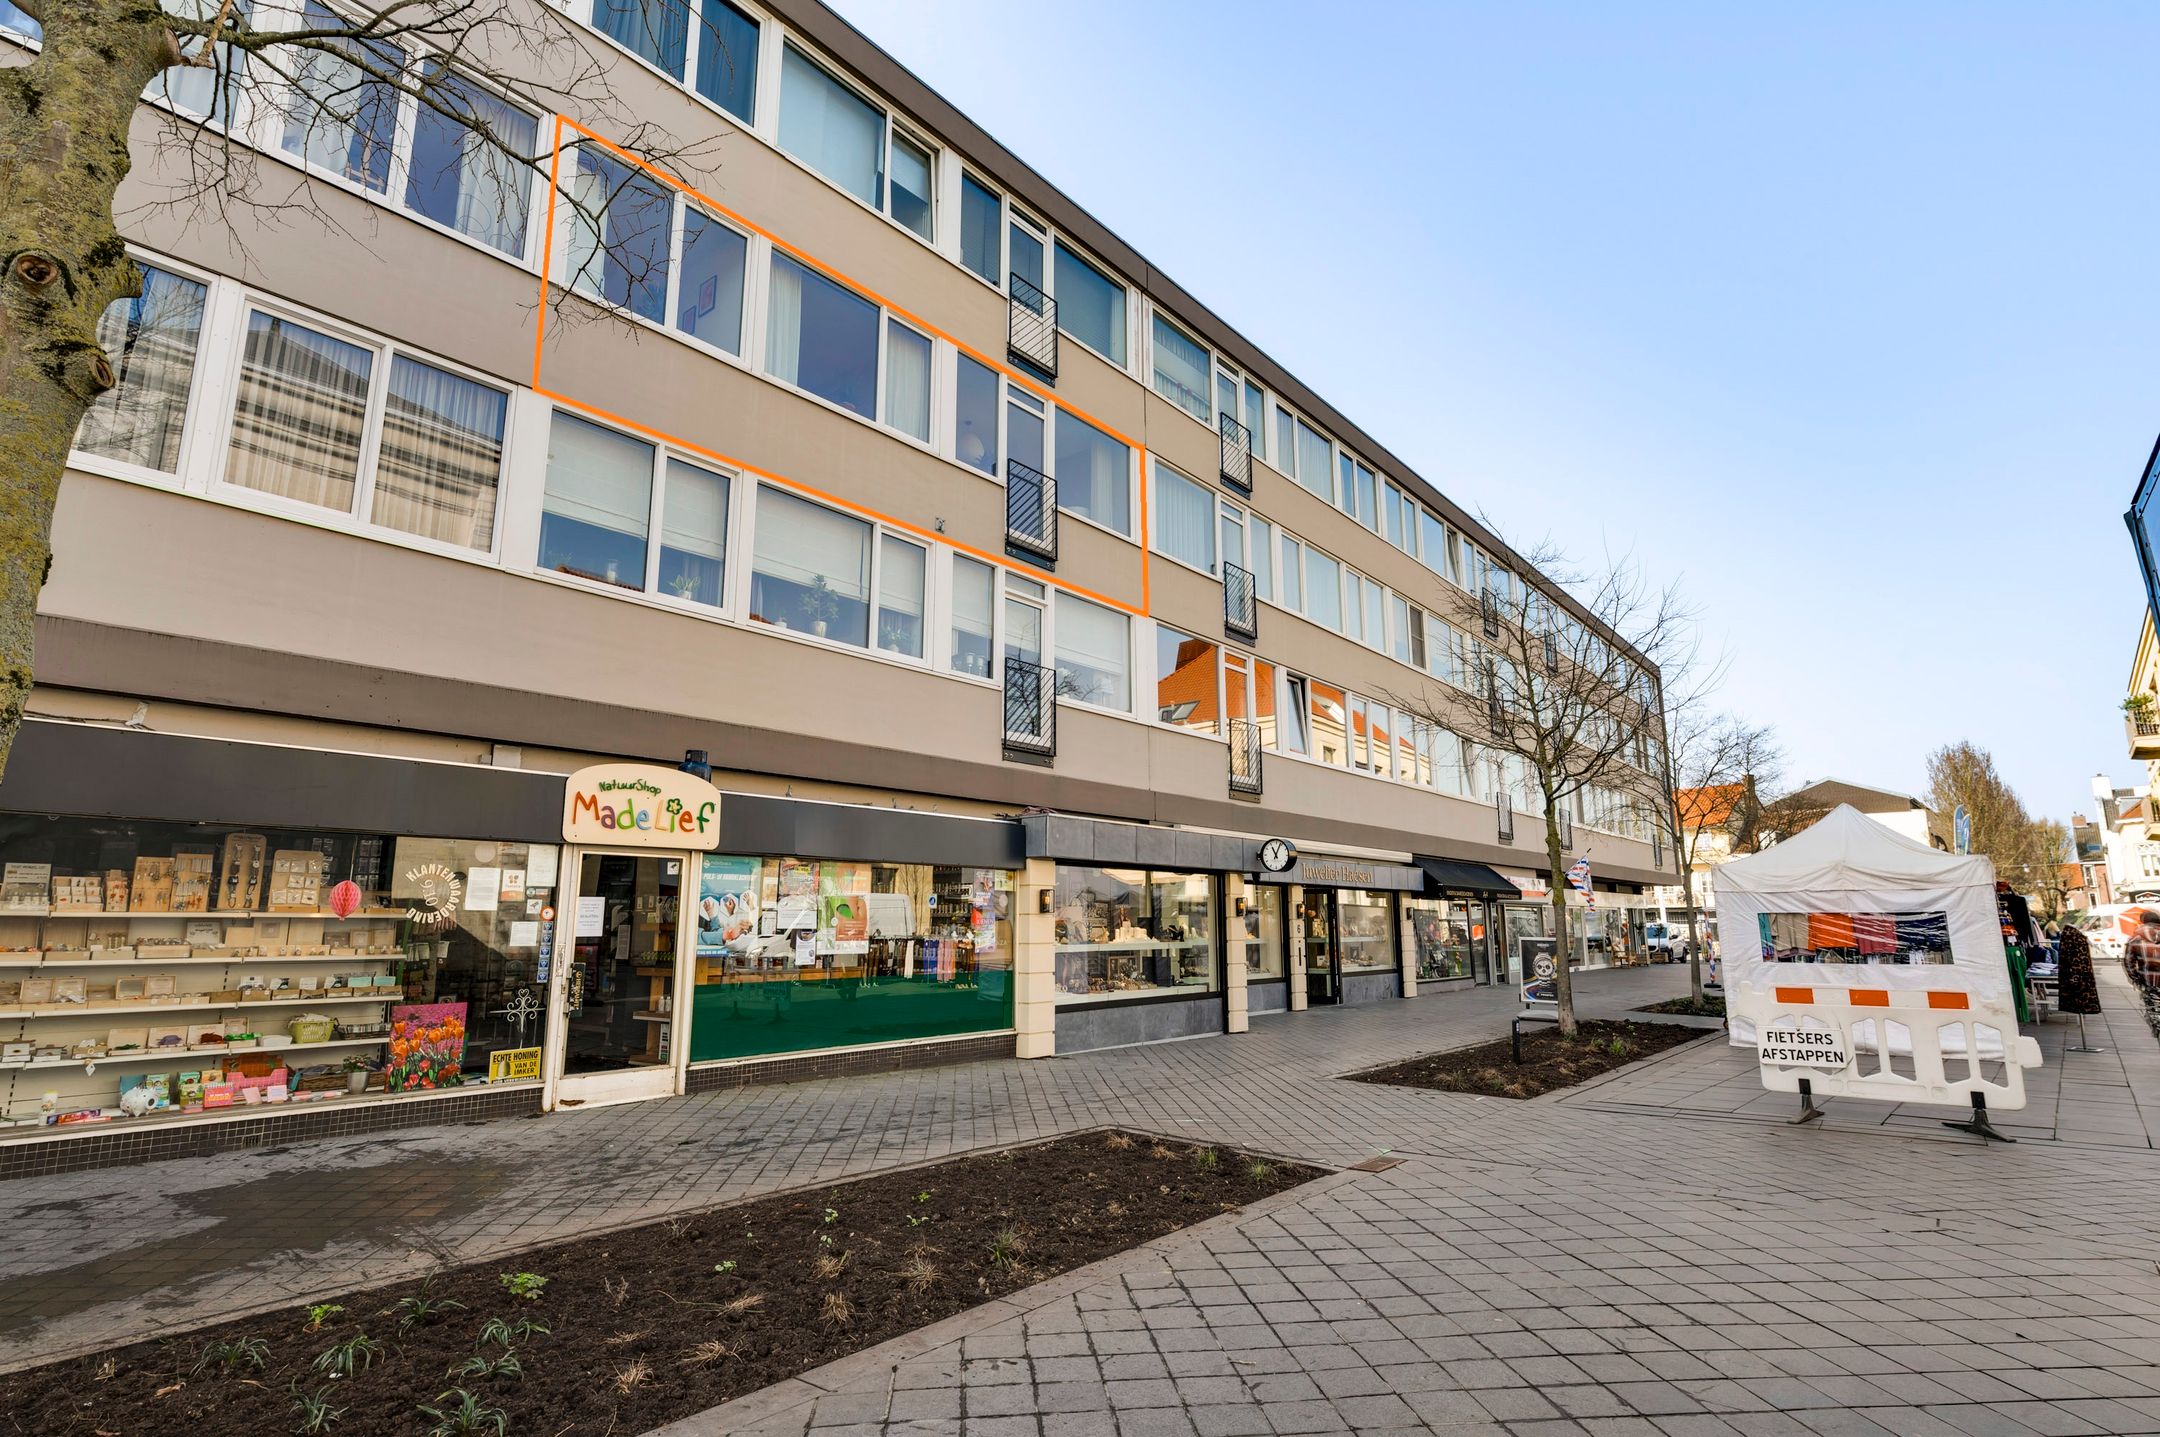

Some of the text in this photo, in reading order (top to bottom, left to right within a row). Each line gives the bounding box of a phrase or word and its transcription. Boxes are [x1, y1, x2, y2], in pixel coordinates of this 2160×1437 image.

[1302, 863, 1340, 880] Juwelier
[405, 863, 461, 924] KLANTENWAARDERING
[1766, 1031, 1833, 1045] FIETSERS
[493, 1051, 538, 1062] ECHTE HONING
[1762, 1048, 1844, 1063] AFSTAPPEN
[513, 1067, 535, 1075] IMKER
